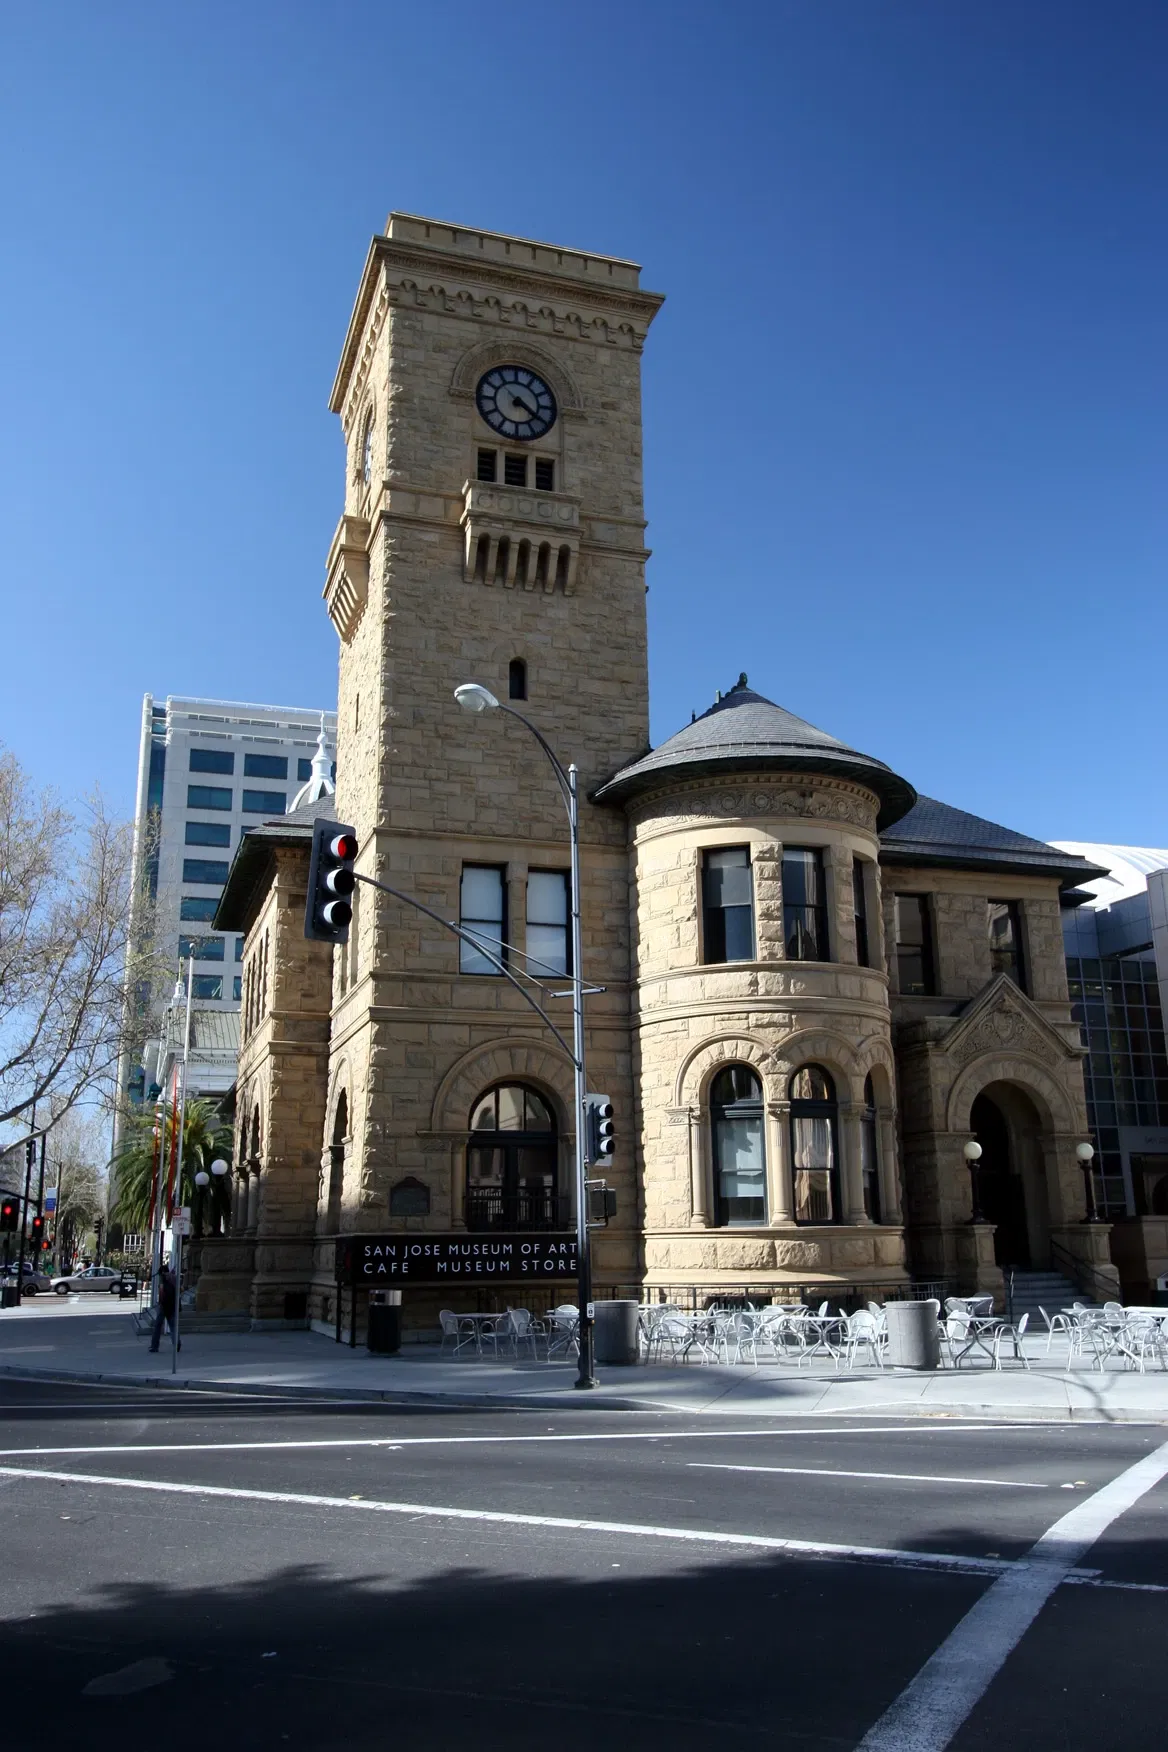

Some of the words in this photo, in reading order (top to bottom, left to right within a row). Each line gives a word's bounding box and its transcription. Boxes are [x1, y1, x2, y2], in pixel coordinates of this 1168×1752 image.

[364, 1245, 396, 1257] SAN
[404, 1245, 441, 1259] JOSE
[448, 1243, 513, 1256] MUSEUM
[520, 1243, 541, 1255] OF
[548, 1243, 578, 1254] ART
[363, 1262, 409, 1274] CAFE
[437, 1260, 511, 1273] MUSEUM
[521, 1259, 577, 1272] STORE
